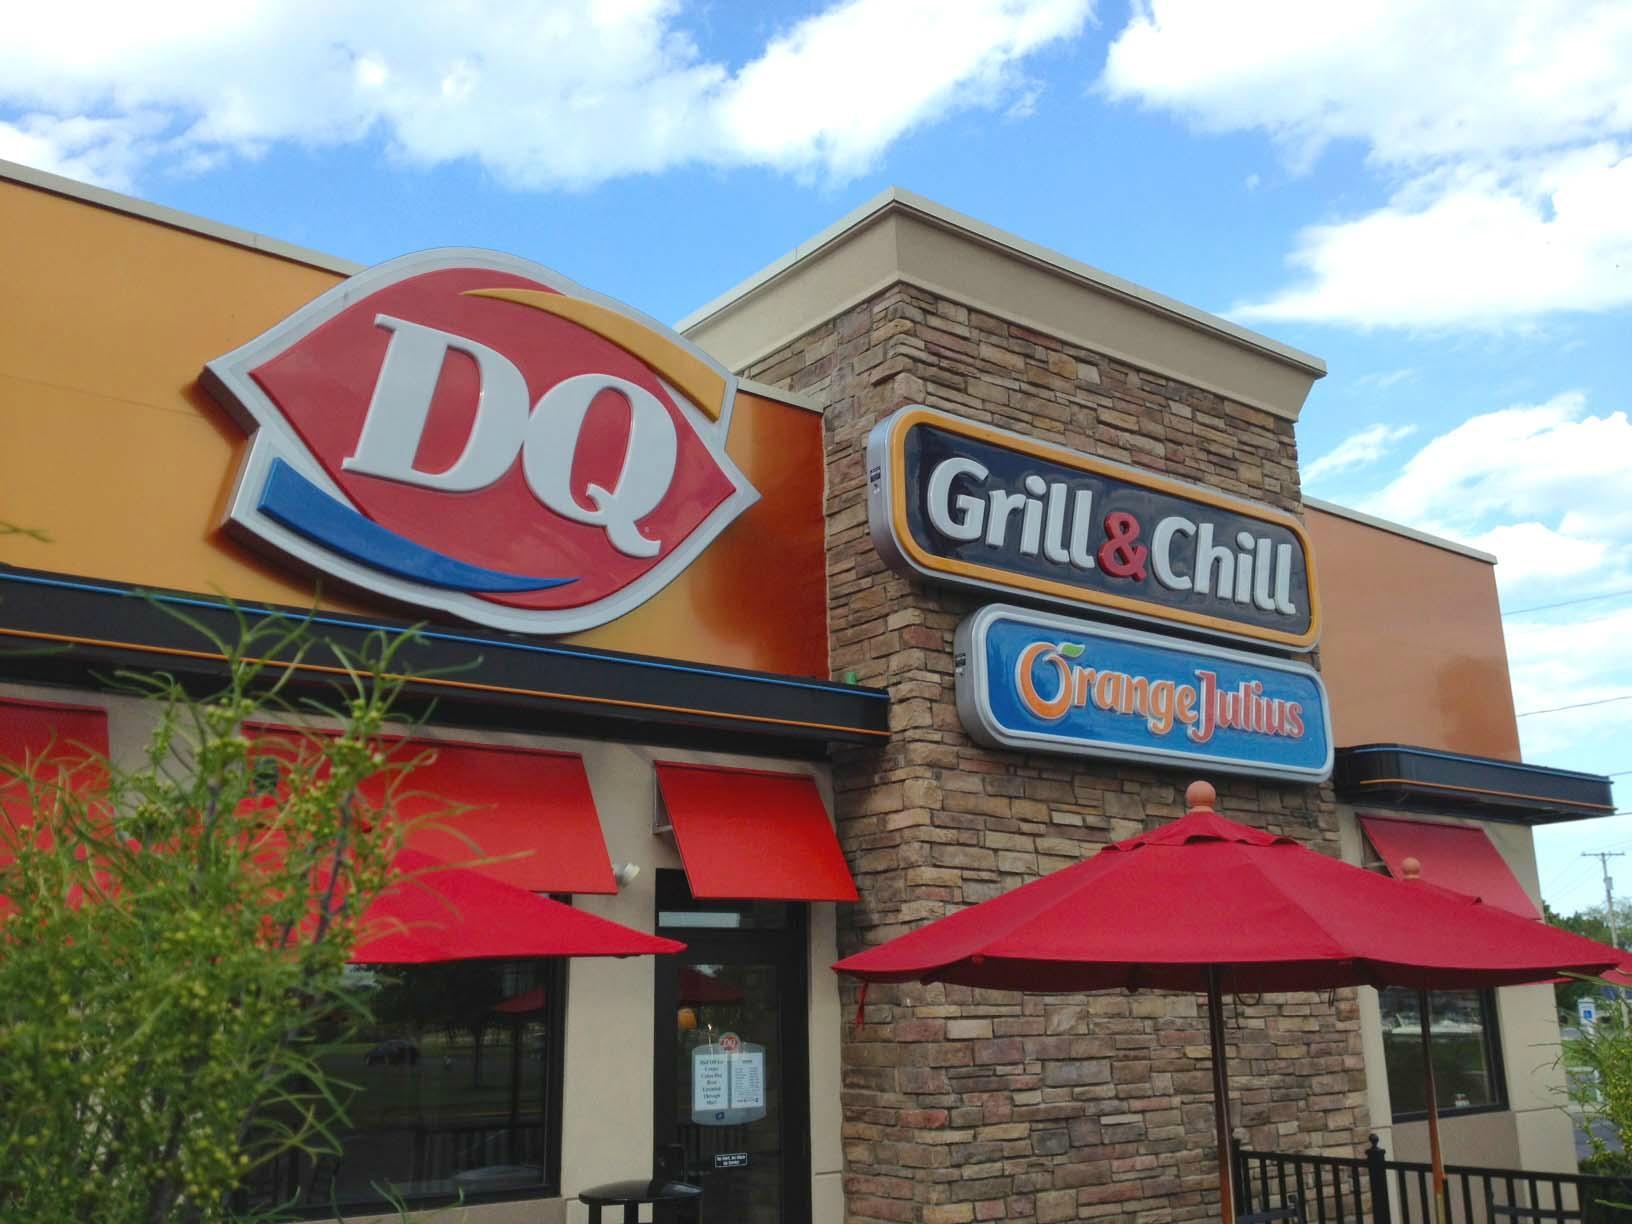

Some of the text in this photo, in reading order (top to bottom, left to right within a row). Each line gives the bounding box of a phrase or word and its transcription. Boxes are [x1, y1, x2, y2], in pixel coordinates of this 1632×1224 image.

[342, 313, 678, 558] DQ
[927, 457, 1296, 615] Grill & Chill
[1015, 641, 1305, 743] Orange Julius
